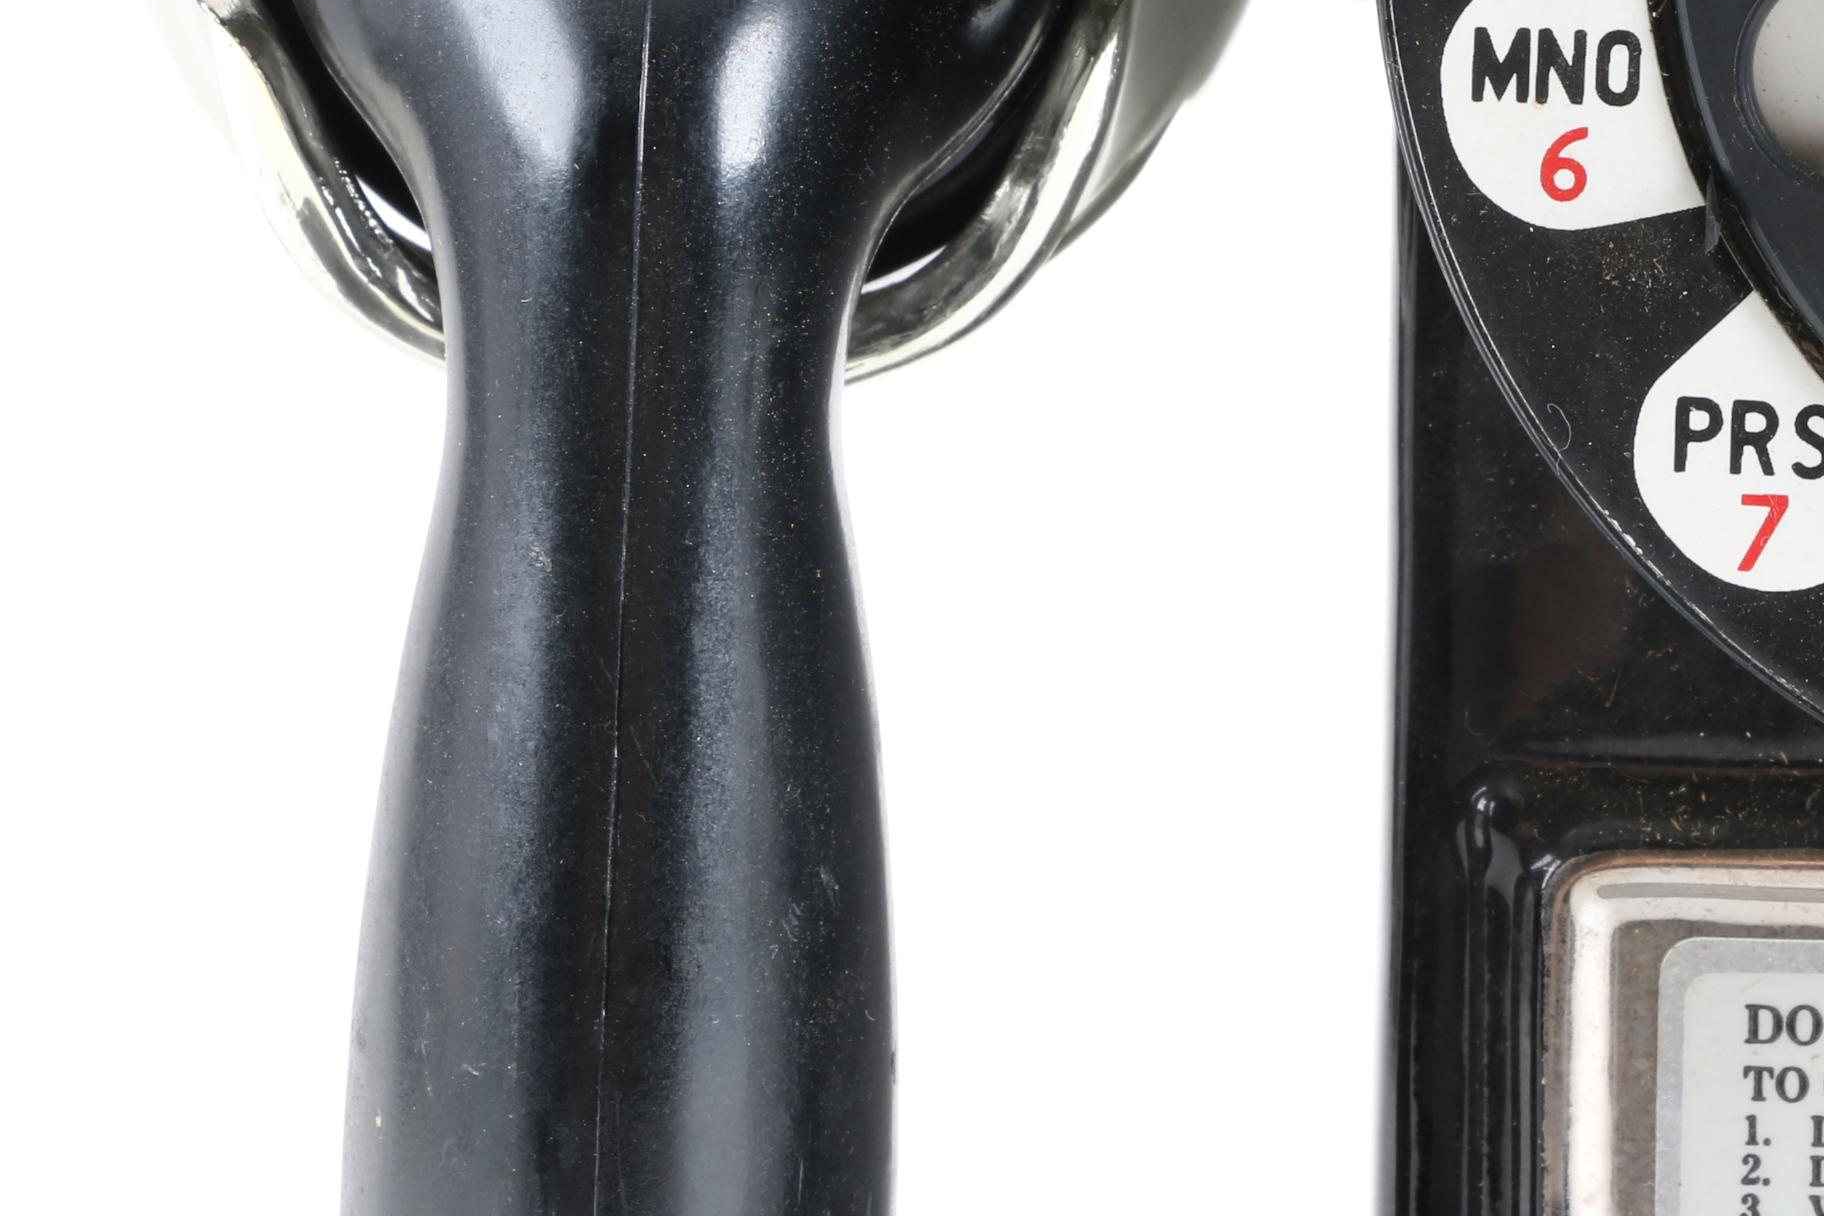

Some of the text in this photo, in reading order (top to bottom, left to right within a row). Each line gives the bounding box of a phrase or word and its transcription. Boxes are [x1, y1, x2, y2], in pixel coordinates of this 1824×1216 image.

[1471, 26, 1642, 107] MNO
[1541, 127, 1588, 202] 6
[1739, 494, 1789, 571] 7
[1744, 1004, 1823, 1046] DO
[1743, 1065, 1809, 1103] TO
[1745, 1114, 1771, 1146] 1.
[1741, 1154, 1770, 1186] 2.
